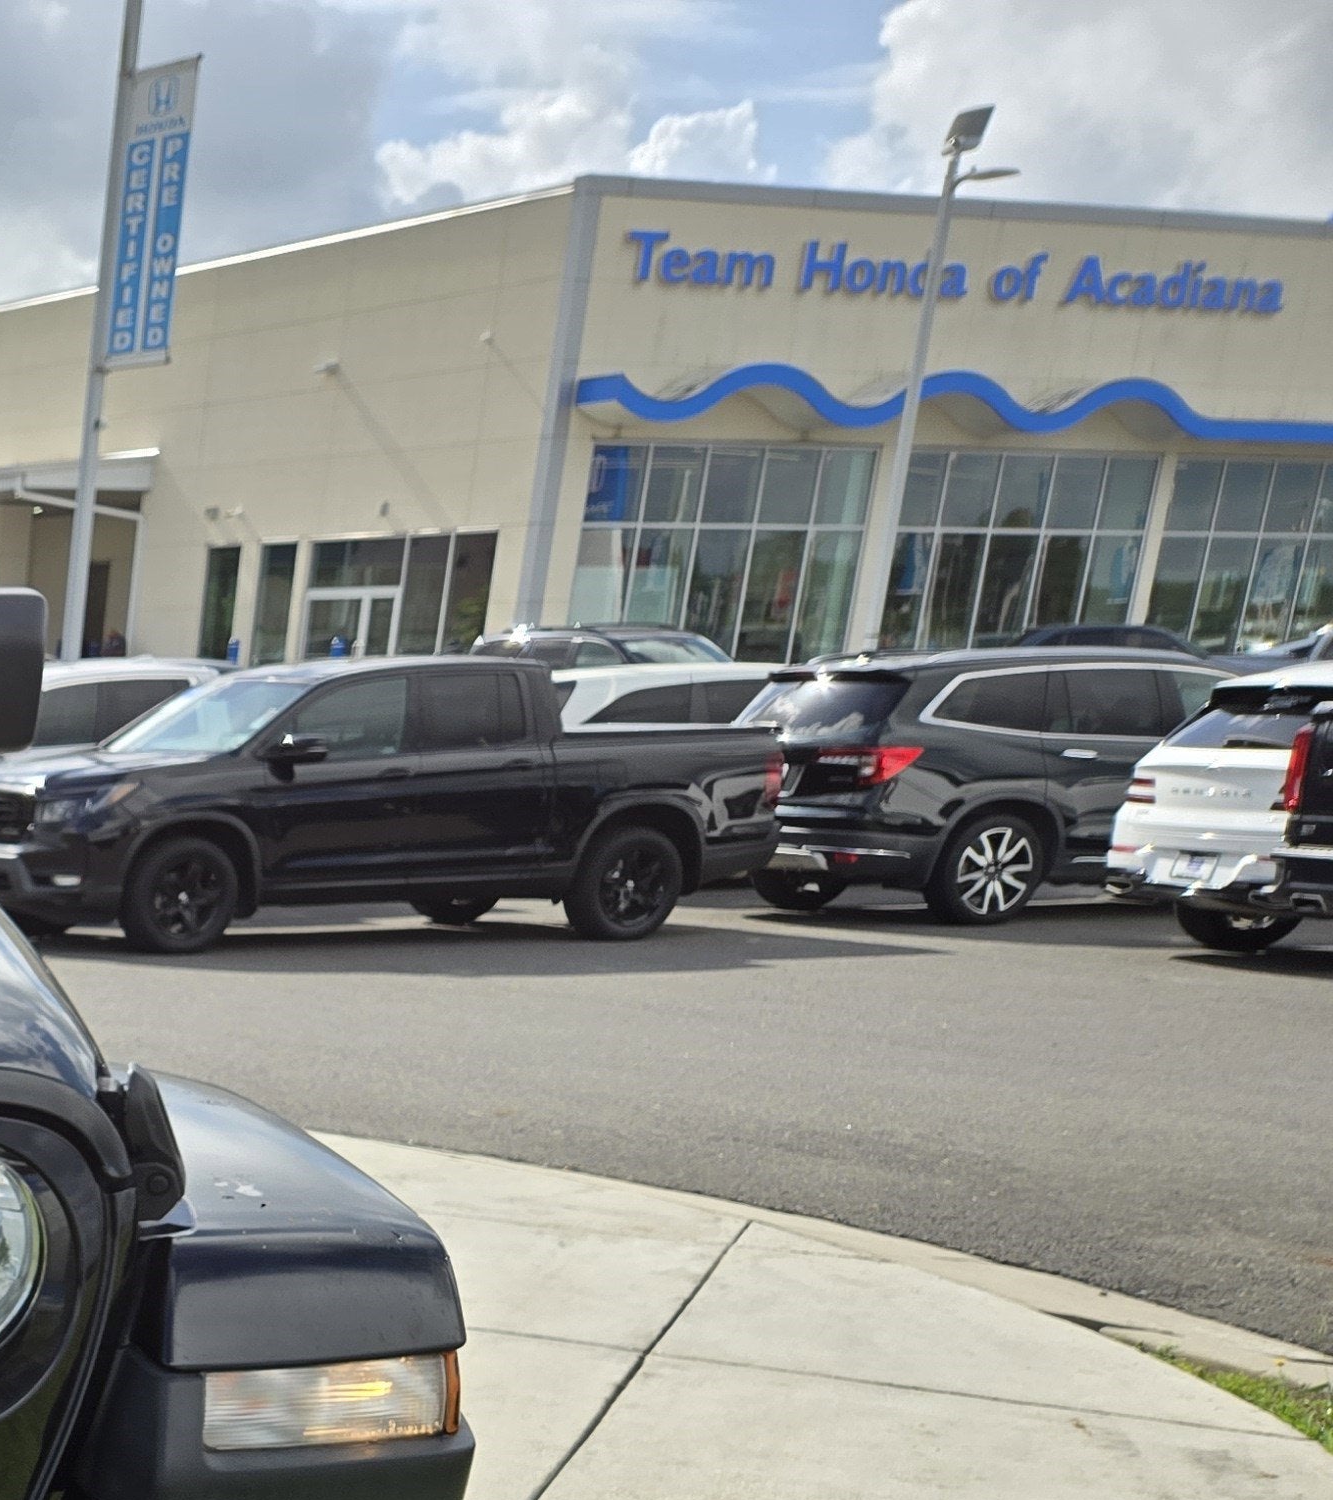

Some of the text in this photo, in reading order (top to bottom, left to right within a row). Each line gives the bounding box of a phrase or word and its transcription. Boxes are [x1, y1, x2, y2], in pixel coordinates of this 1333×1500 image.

[112, 144, 151, 350] CERTIFIED
[146, 137, 184, 347] PRE OWNED
[627, 229, 776, 289] Team
[992, 251, 1049, 301] of
[1063, 254, 1282, 314] Acadiana
